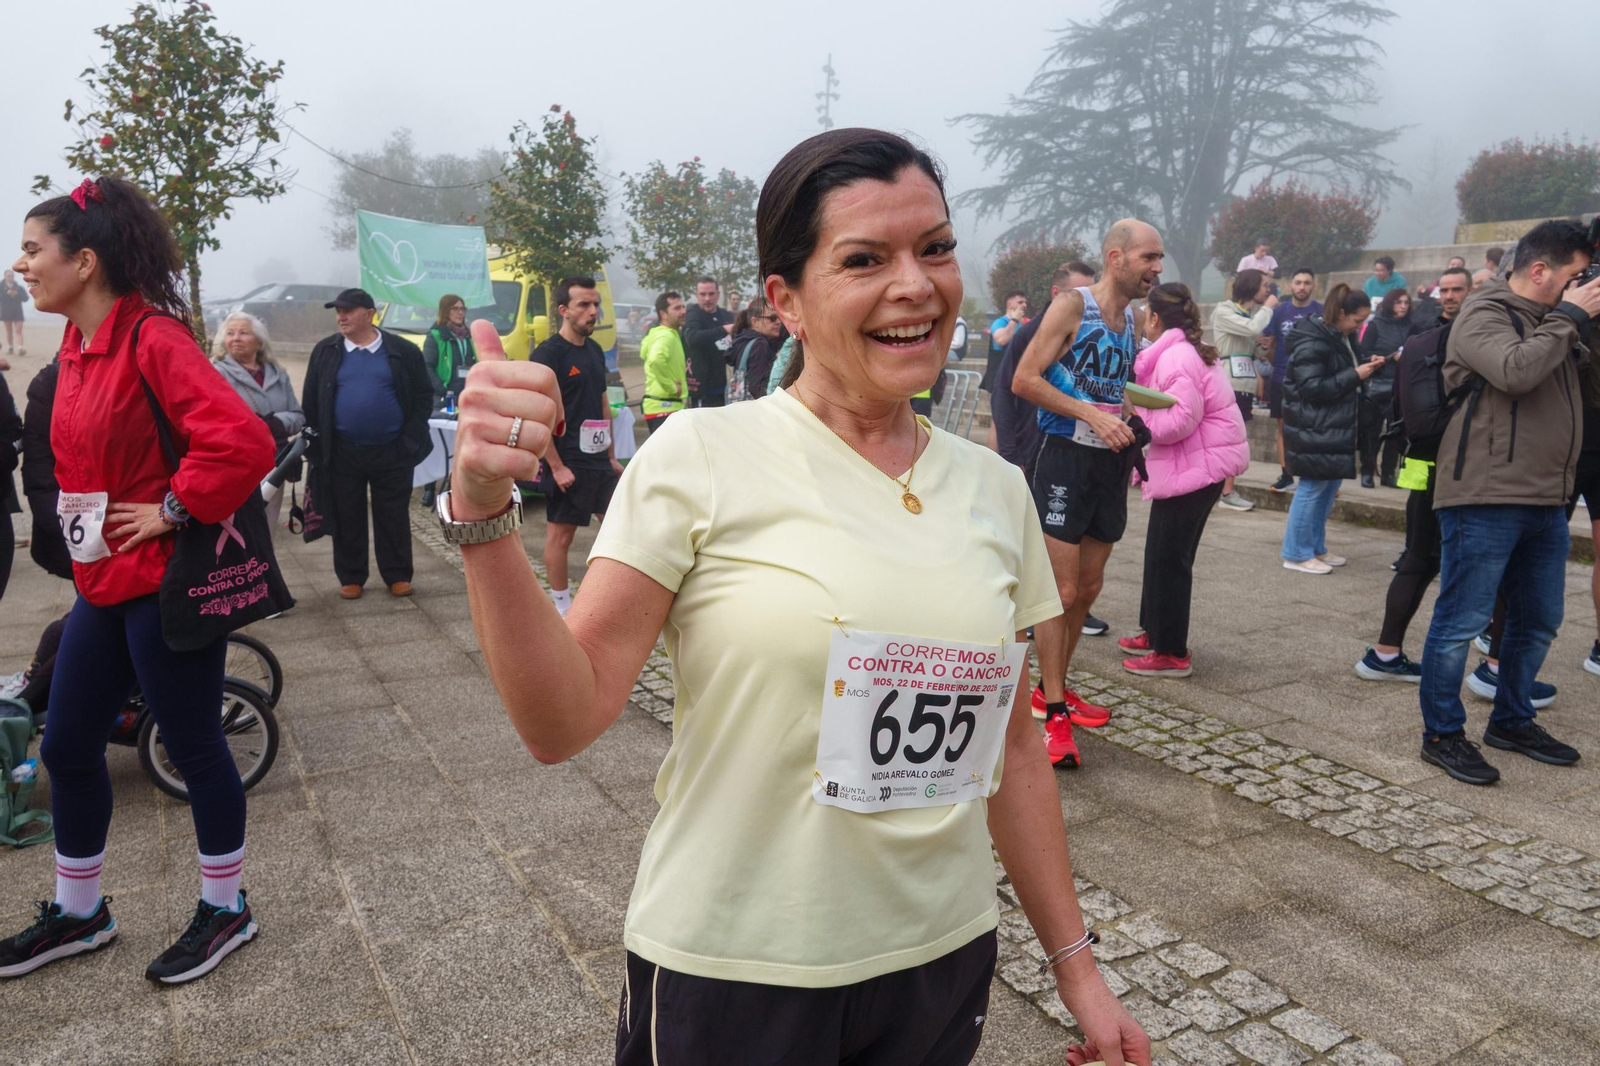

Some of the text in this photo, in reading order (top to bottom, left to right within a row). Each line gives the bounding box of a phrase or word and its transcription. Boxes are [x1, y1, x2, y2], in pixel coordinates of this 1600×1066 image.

[1238, 362, 1252, 372] 511
[593, 430, 605, 445] 60
[1045, 511, 1066, 523] ADN
[188, 579, 234, 597] CONTRA
[235, 576, 245, 586] O
[886, 642, 996, 665] CORREMOS
[847, 656, 1011, 680] CONTRA O CANCRO
[873, 677, 894, 688] MOS,
[897, 678, 908, 688] 22
[910, 680, 923, 689] DE
[926, 681, 968, 692] FEBREIRO
[970, 684, 981, 692] DE
[982, 683, 998, 693] 2026
[847, 688, 870, 698] MOS
[869, 689, 985, 766] 655
[871, 768, 955, 781] NIDIA AREVALO GOMEZ
[839, 792, 877, 802] DE GALICIA
[840, 785, 866, 795] XUNTA
